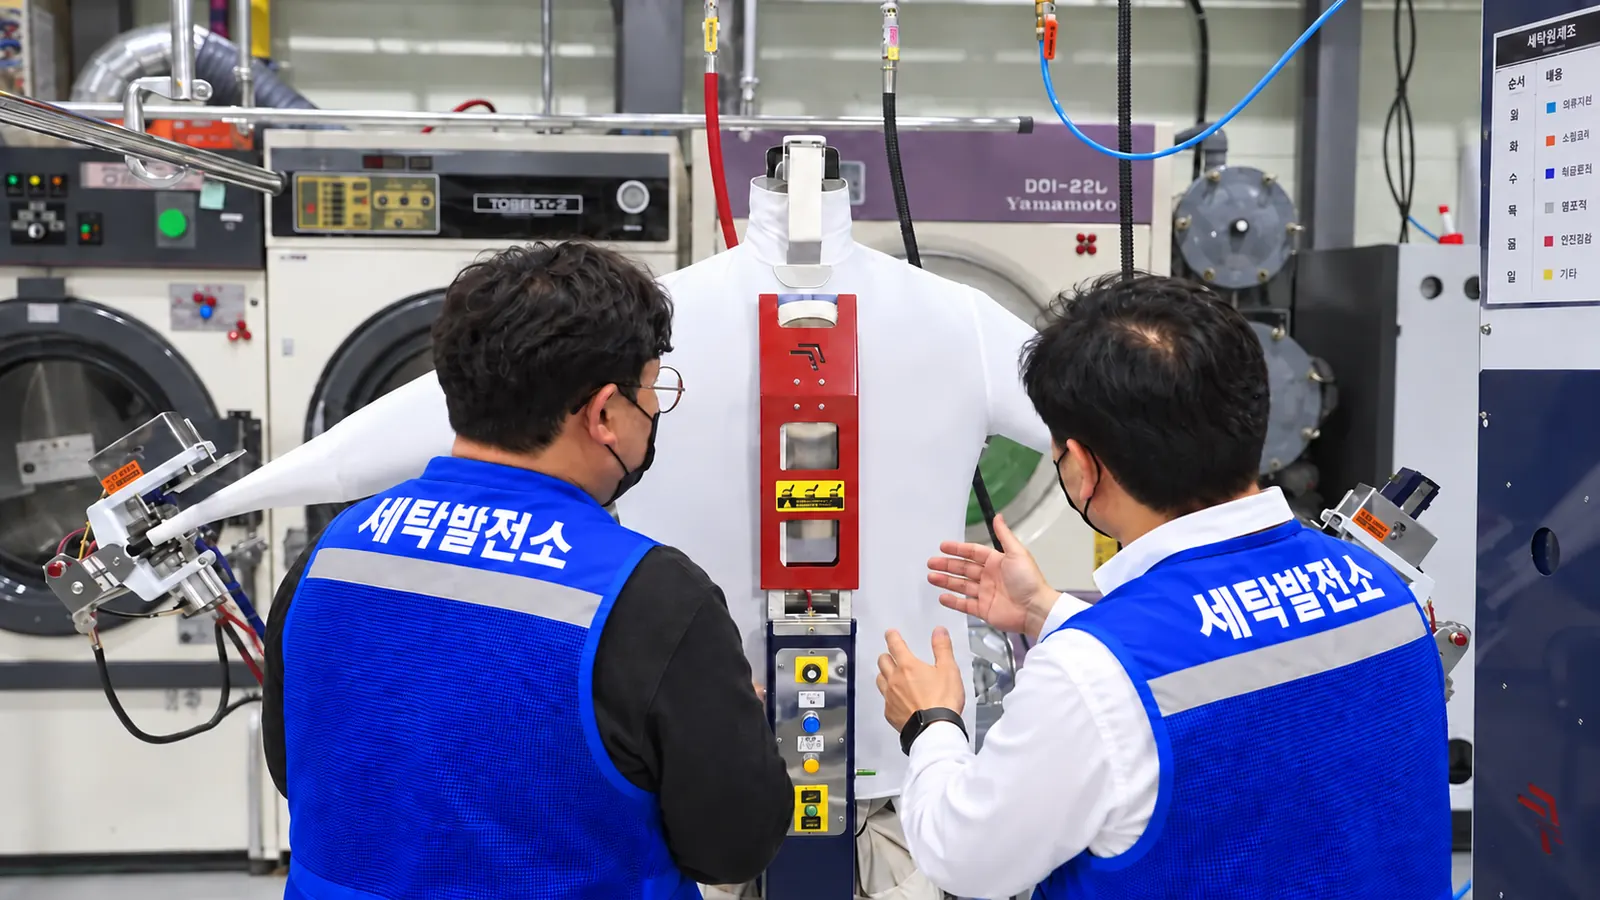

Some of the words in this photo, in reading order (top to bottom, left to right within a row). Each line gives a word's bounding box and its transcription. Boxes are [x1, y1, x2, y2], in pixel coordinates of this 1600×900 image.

[1509, 173, 1518, 184] 수
[1006, 196, 1117, 212] Yamamoto
[1507, 270, 1516, 283] 일
[1560, 268, 1577, 280] 기타
[358, 497, 572, 570] 세탁발전소
[1193, 554, 1386, 640] 세탁발전소
